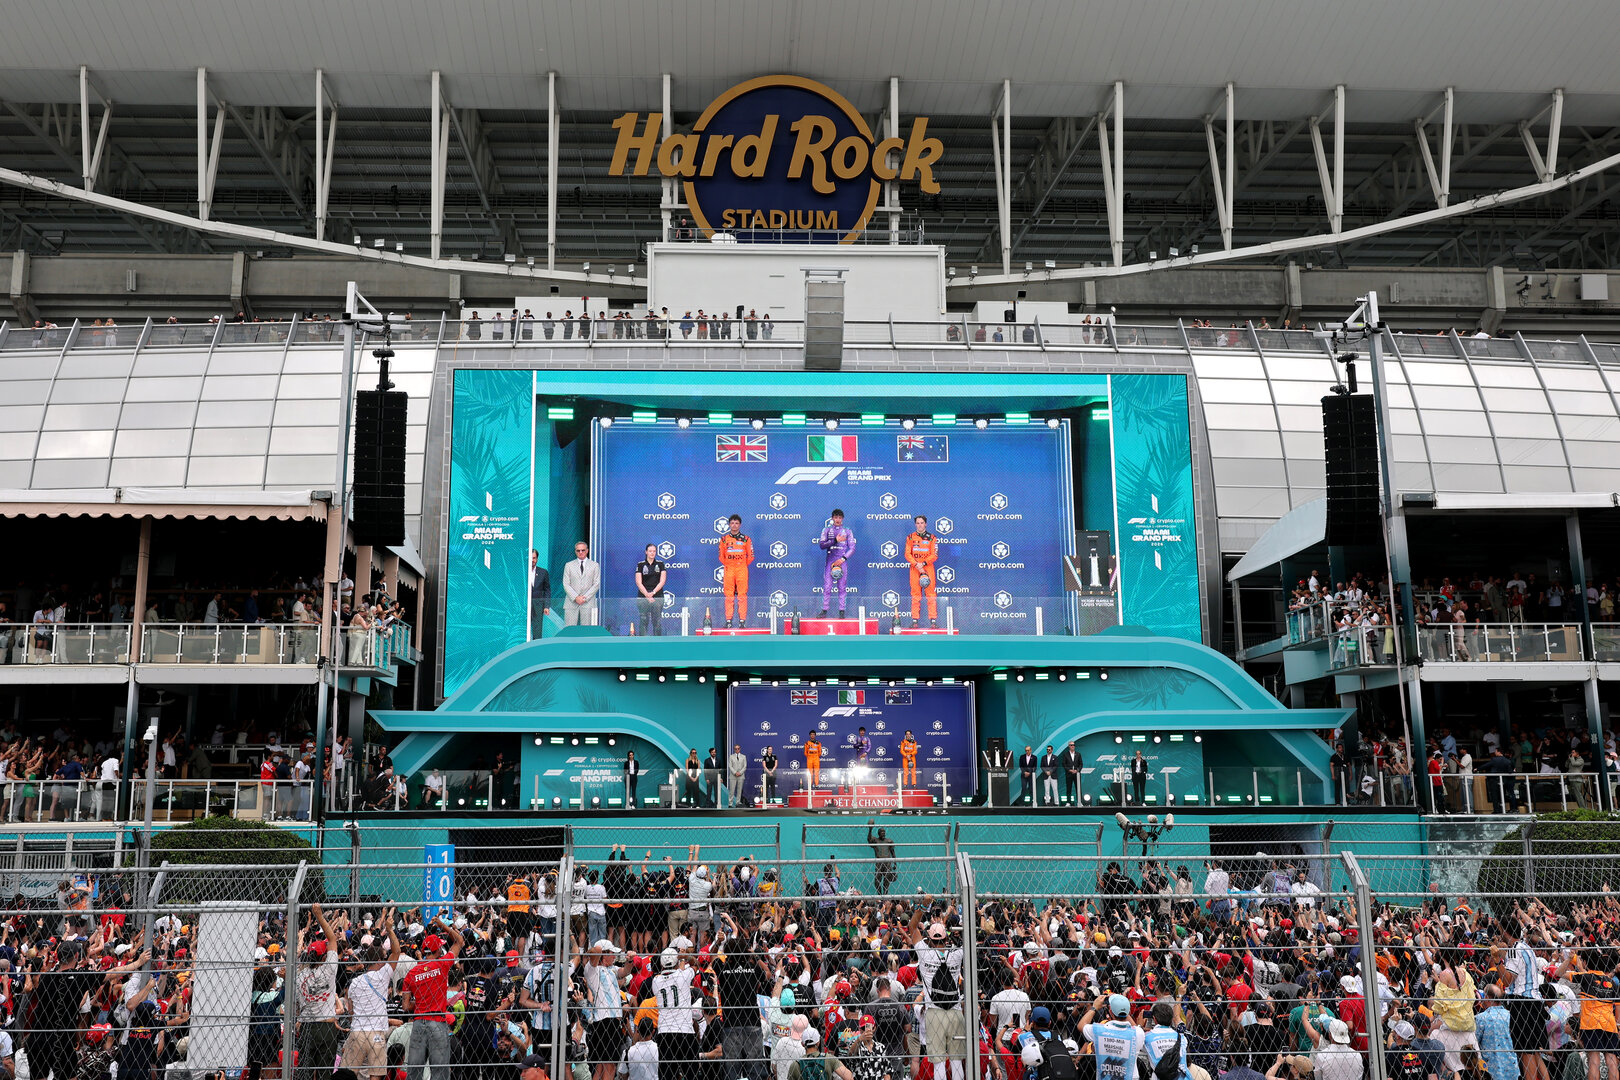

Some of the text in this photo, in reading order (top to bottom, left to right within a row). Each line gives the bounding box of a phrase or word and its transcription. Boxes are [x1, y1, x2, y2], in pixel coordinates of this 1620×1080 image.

[608, 112, 945, 195] Hard Rock
[721, 209, 839, 230] STADIUM
[643, 513, 690, 521] crypto.com
[756, 513, 801, 521] crypto.com
[866, 513, 912, 521] crypto.com
[977, 513, 1023, 521] crypto.com
[756, 561, 802, 569] crypto.com
[978, 562, 1025, 570] crypto.com
[980, 611, 1027, 619] crypto.com
[827, 625, 836, 635] 1
[569, 775, 623, 783] GRAND PRIX
[415, 968, 441, 982] Ferrari
[660, 985, 679, 1008] 11
